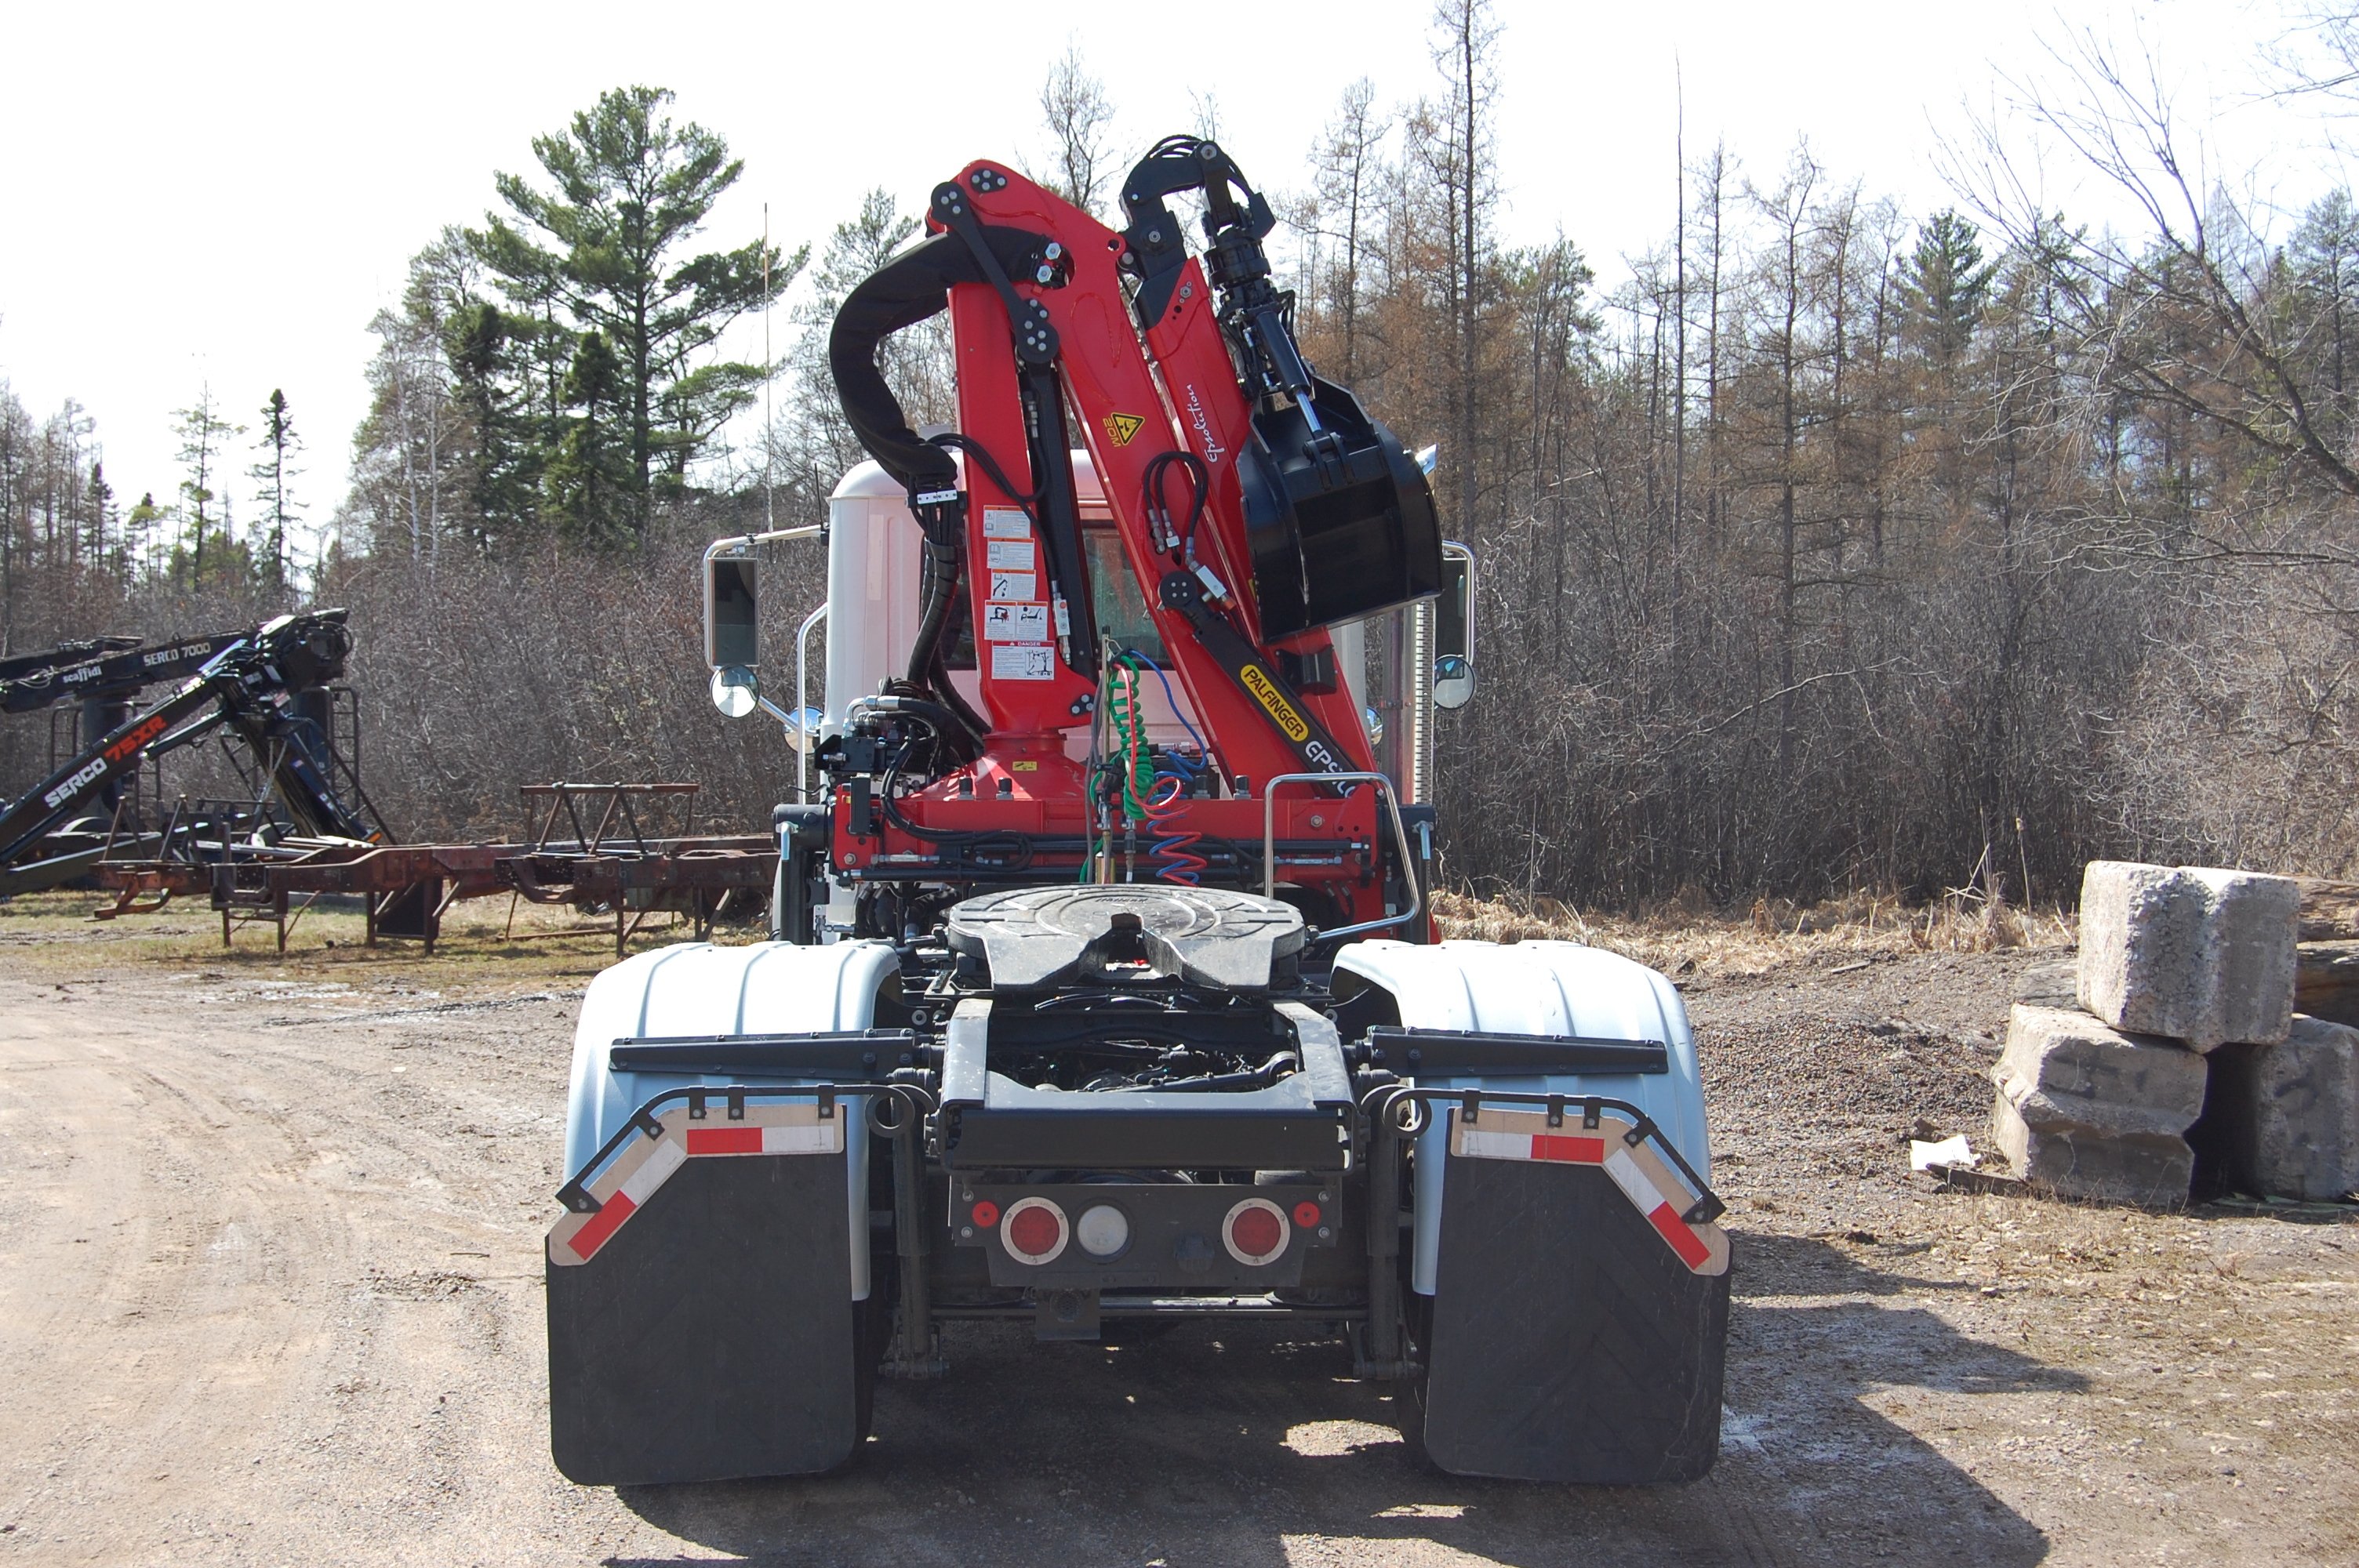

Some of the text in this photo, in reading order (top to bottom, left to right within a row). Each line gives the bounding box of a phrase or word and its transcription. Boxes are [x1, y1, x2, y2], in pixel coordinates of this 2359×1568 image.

[1103, 417, 1122, 448] 20M
[1187, 383, 1225, 463] Epsolution
[63, 666, 102, 683] scaffidi
[144, 642, 211, 666] SERCO 7000
[1244, 668, 1305, 738] PALFINGER
[44, 714, 168, 809] SERCO 75XR
